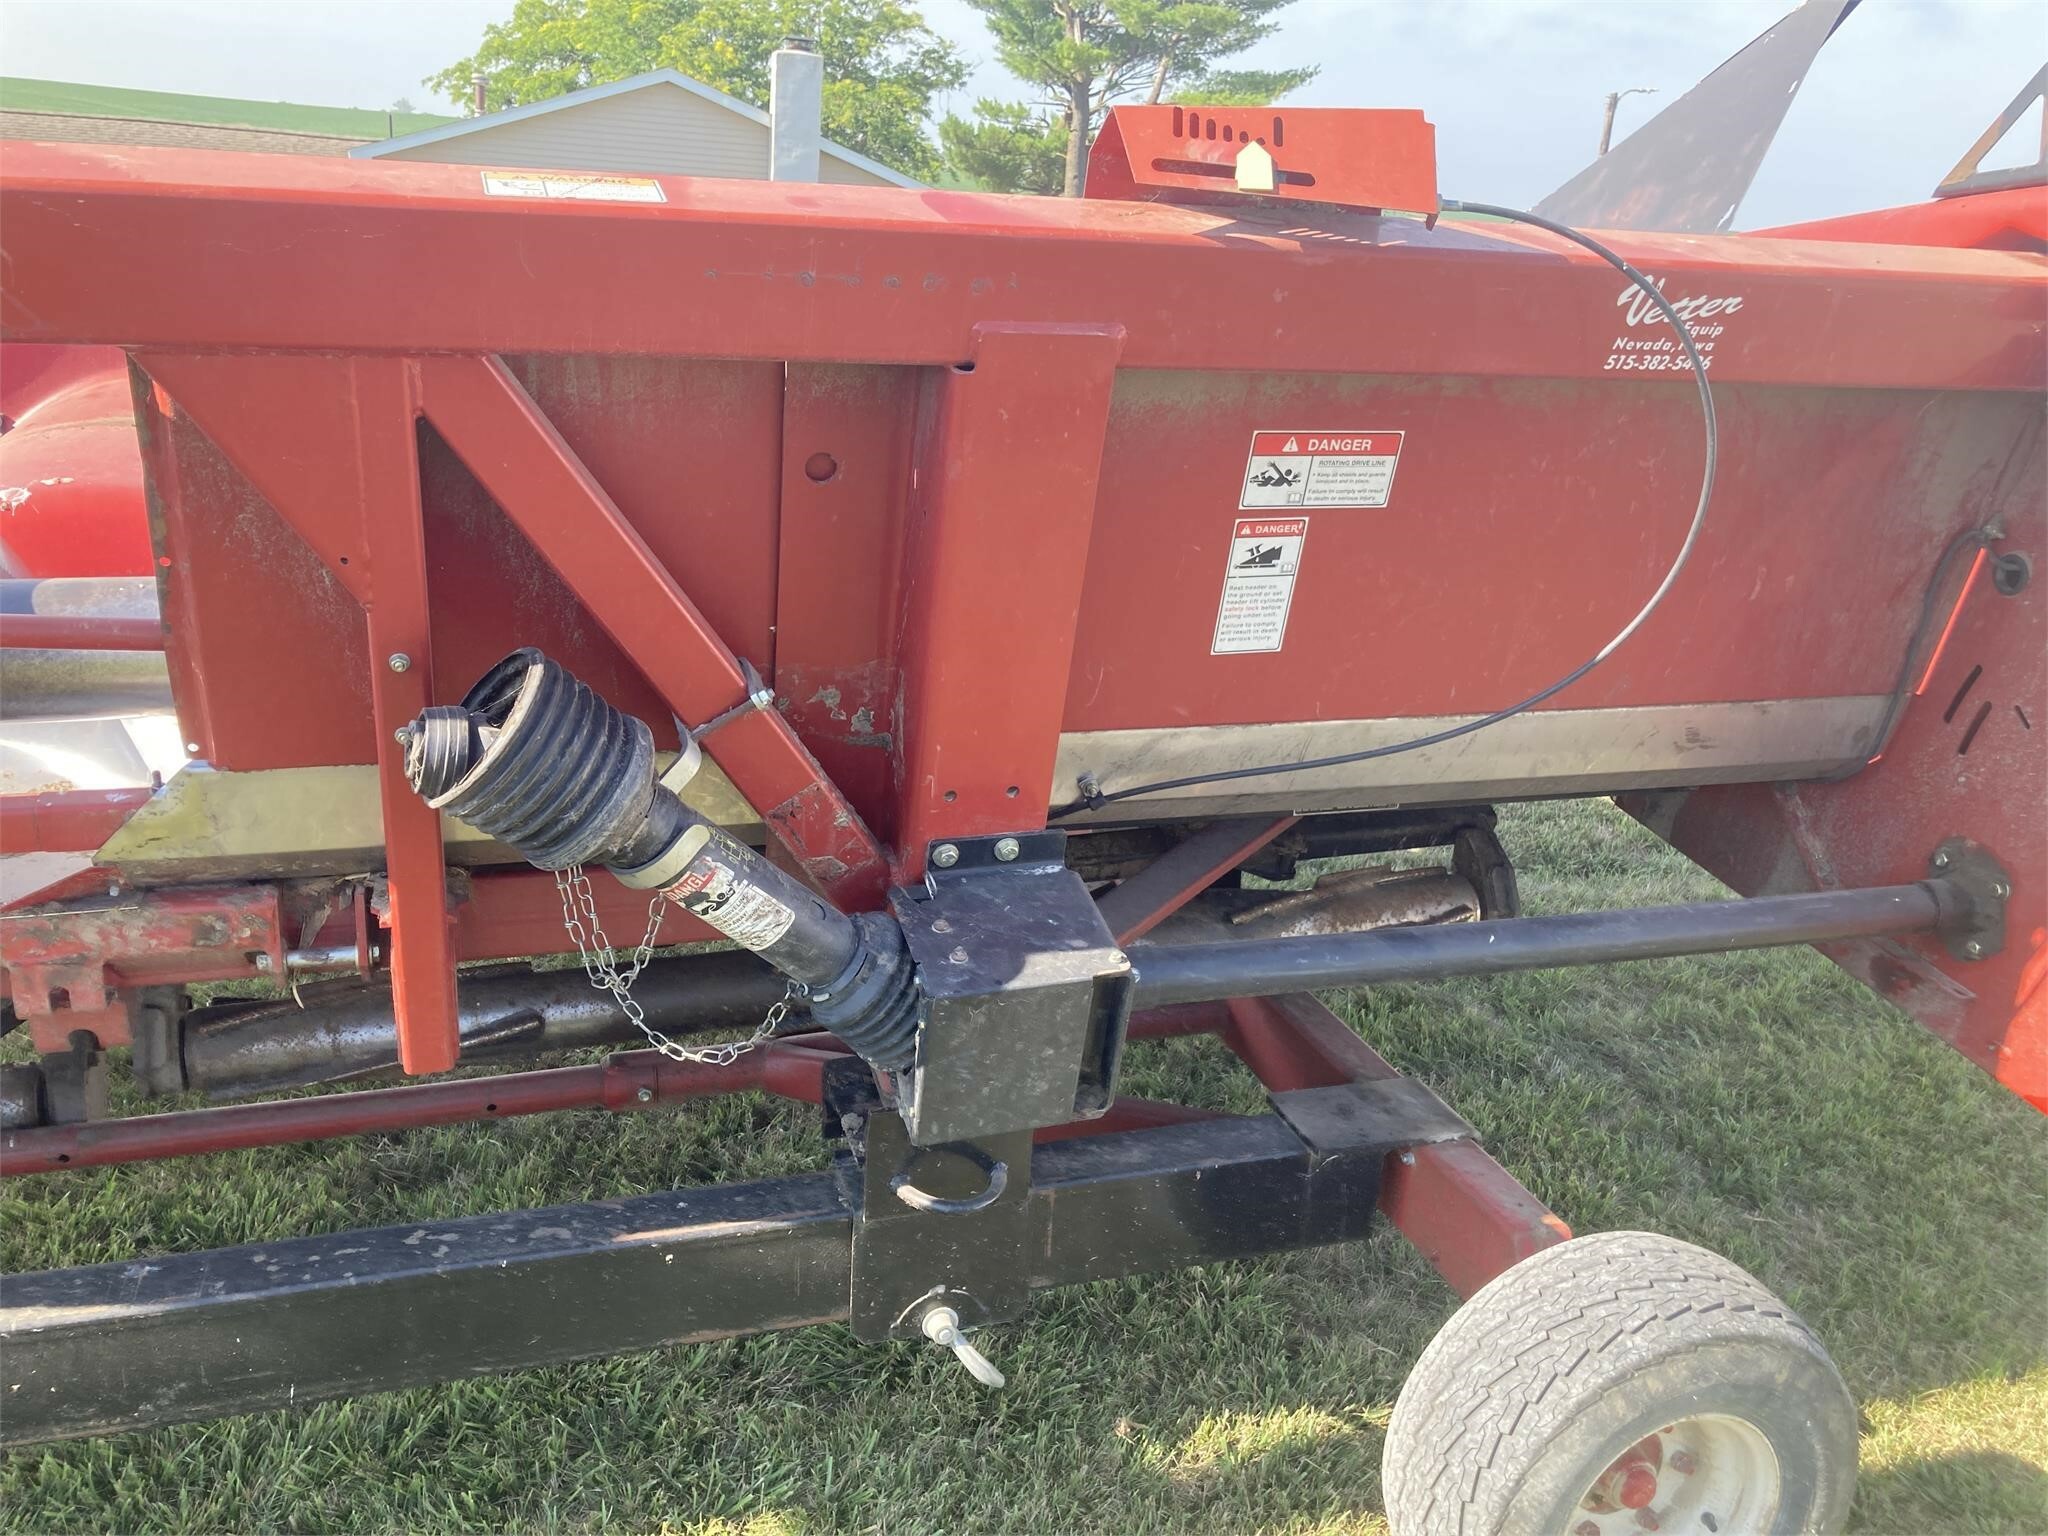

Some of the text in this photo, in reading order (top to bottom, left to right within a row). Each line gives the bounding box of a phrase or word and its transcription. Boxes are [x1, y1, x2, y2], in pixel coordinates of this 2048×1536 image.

[1617, 275, 1743, 327] Vetter
[1612, 337, 1715, 353] Nevada, Iwa
[1308, 439, 1372, 451] DANGER
[1255, 525, 1298, 534] DANGER
[1260, 597, 1286, 605] cylinder
[1224, 605, 1244, 613] safety
[1223, 613, 1242, 621] going
[1221, 621, 1244, 629] Failure
[1253, 620, 1276, 628] comply
